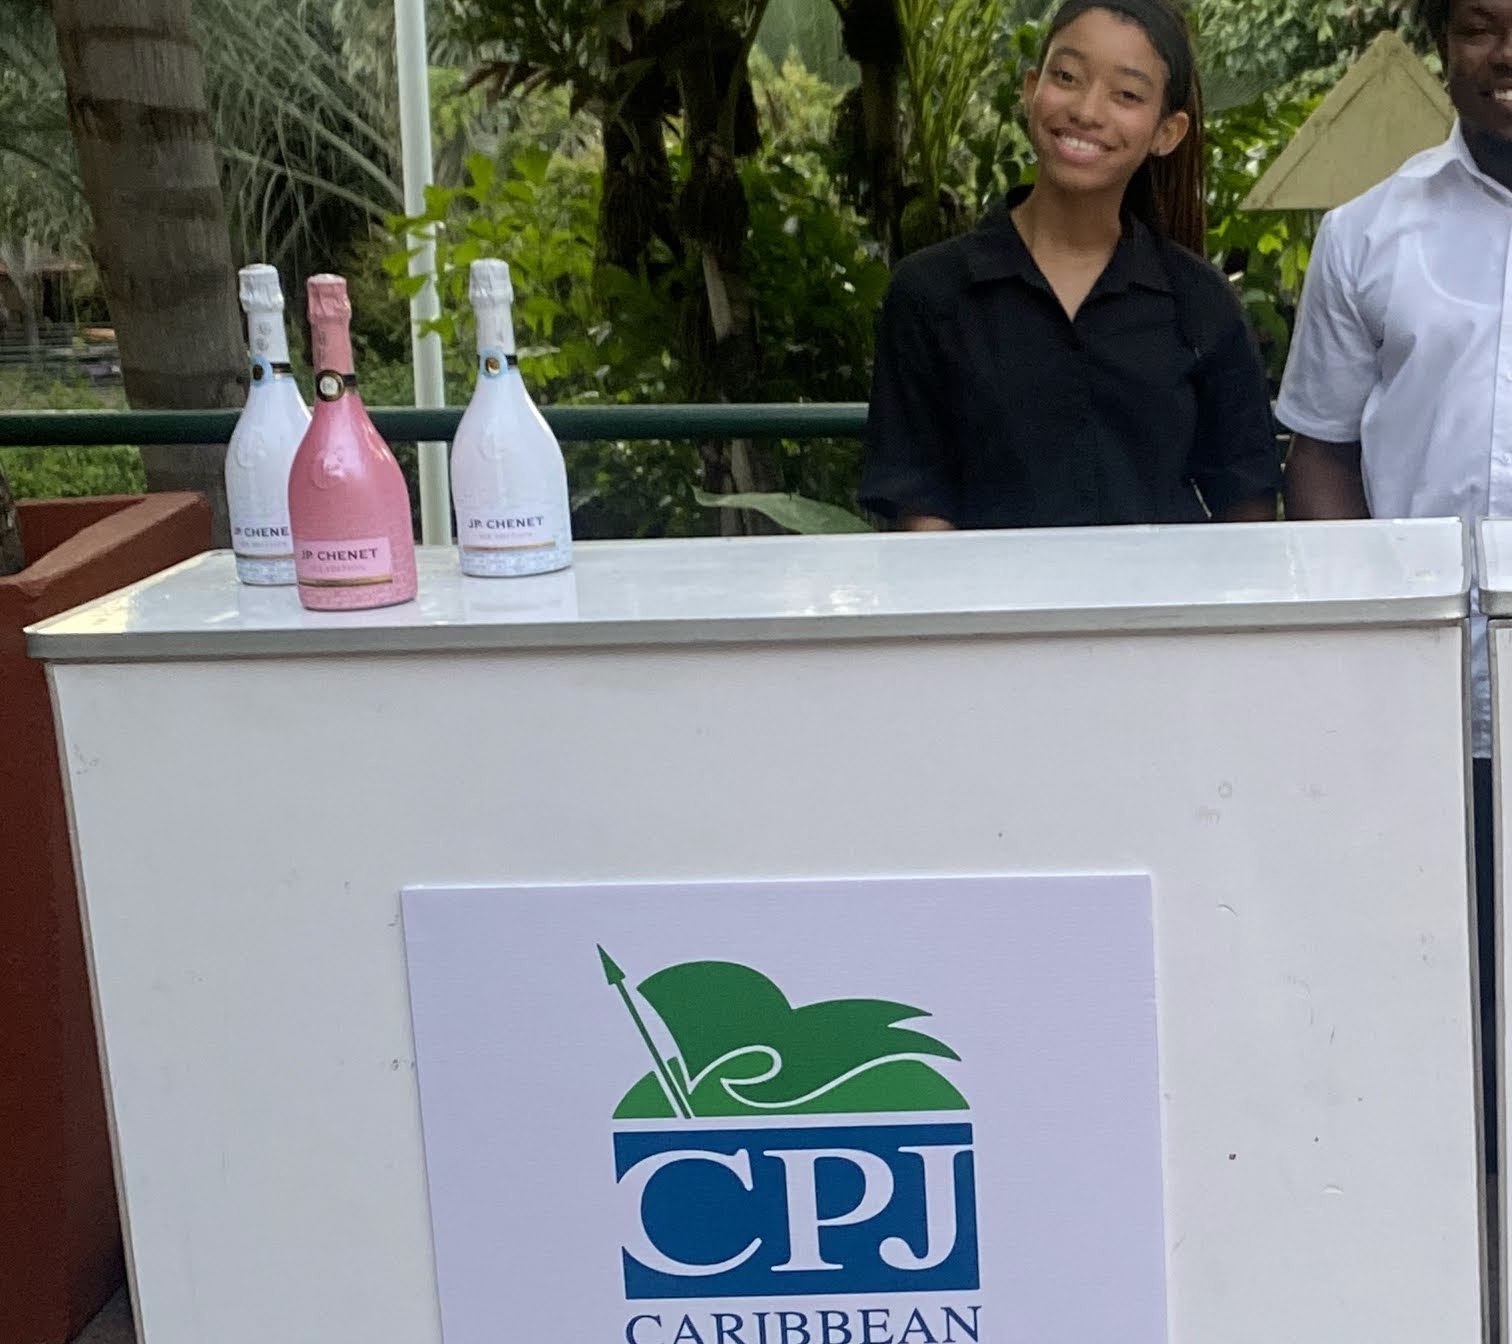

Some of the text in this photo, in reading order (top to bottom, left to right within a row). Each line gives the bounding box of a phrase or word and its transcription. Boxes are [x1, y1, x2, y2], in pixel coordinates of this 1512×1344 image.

[486, 516, 544, 530] CHENET
[244, 524, 290, 537] CHENE
[317, 547, 378, 561] CHENET
[616, 1143, 972, 1276] CPJ
